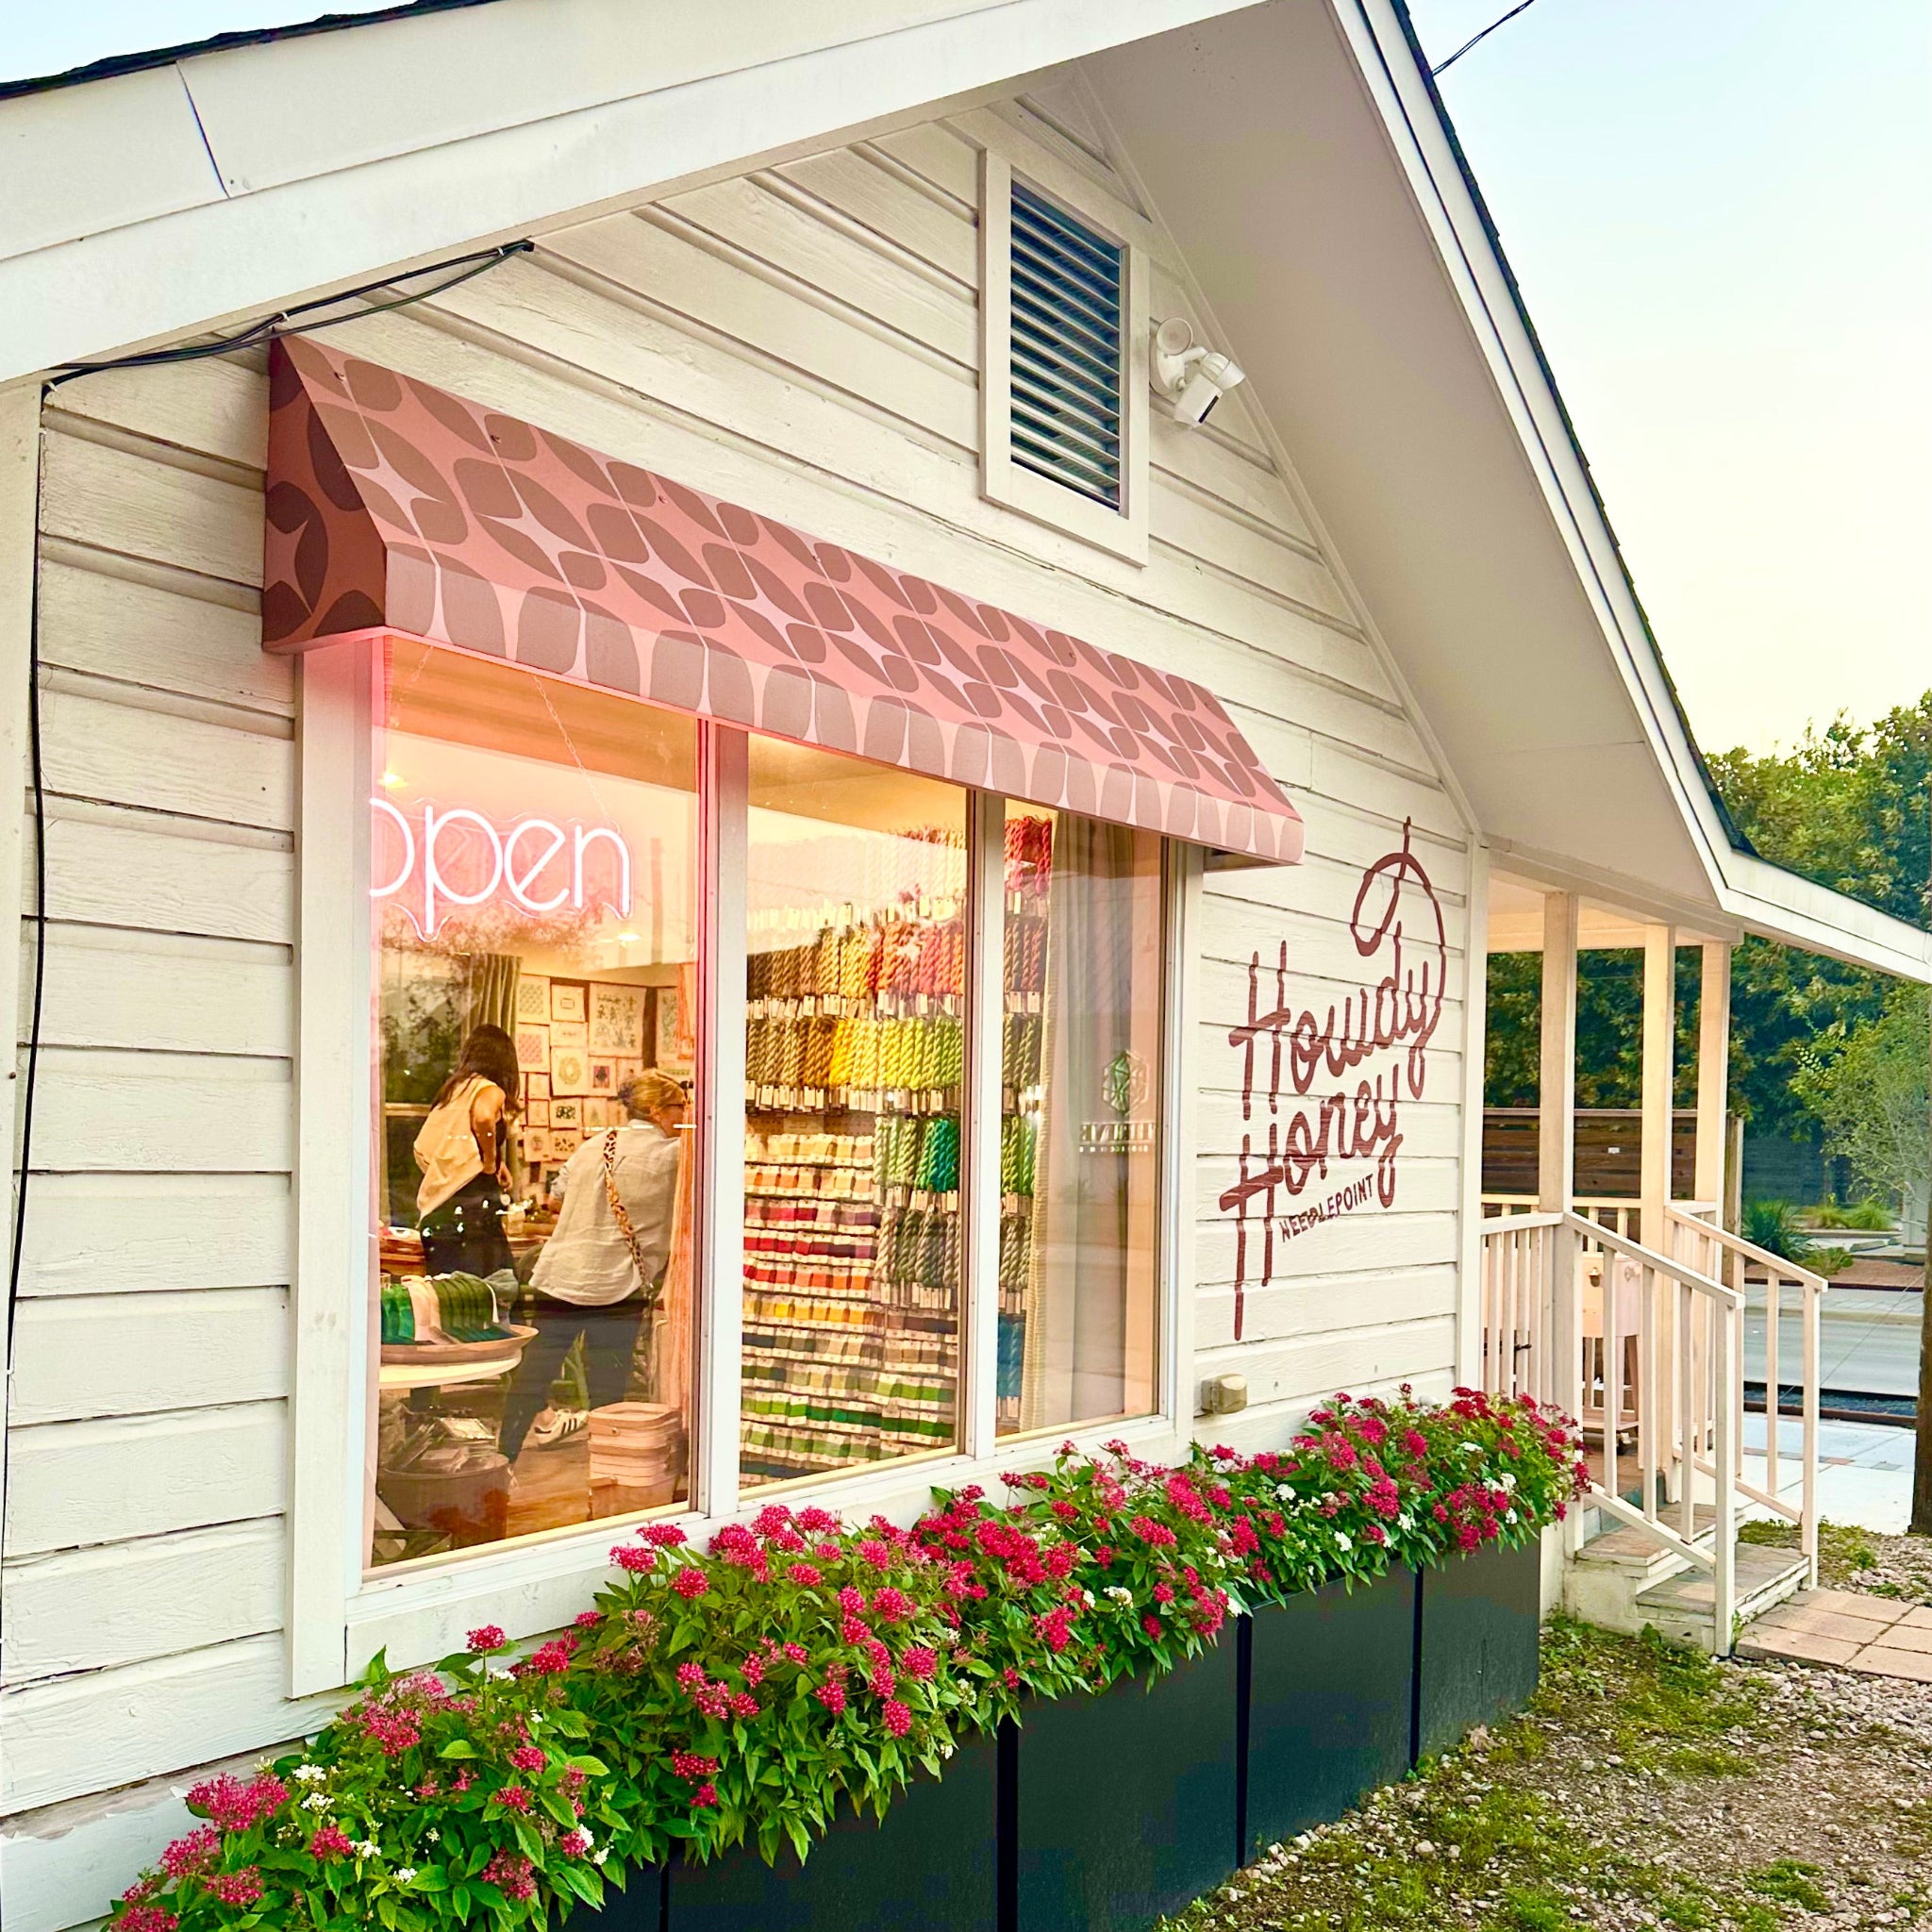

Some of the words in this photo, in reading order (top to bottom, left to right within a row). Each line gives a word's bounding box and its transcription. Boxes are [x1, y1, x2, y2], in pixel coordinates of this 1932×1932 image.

[1228, 816, 1446, 1121] Howdy
[1220, 1063, 1403, 1341] Honey
[1279, 1174, 1374, 1242] NEEDLEPOINT
